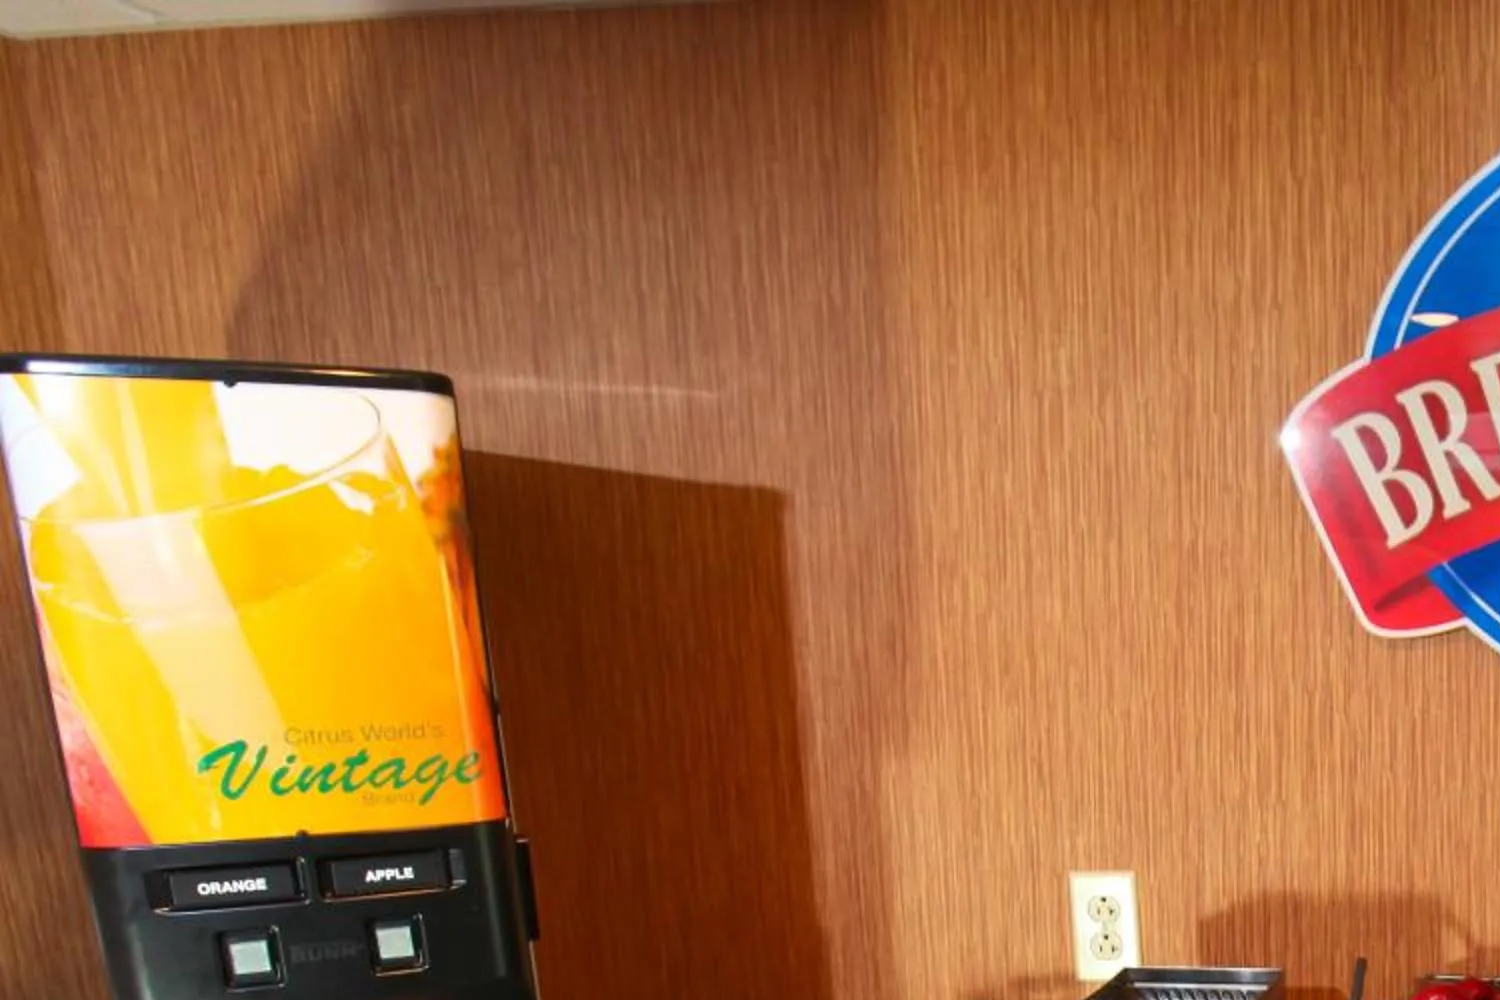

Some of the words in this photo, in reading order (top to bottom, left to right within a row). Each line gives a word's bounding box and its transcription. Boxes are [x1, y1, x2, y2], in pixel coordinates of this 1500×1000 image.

[284, 727, 354, 746] Citrus
[360, 721, 446, 742] World's
[199, 741, 482, 805] Vintage
[365, 865, 416, 884] APPLE
[197, 877, 268, 897] ORANGE
